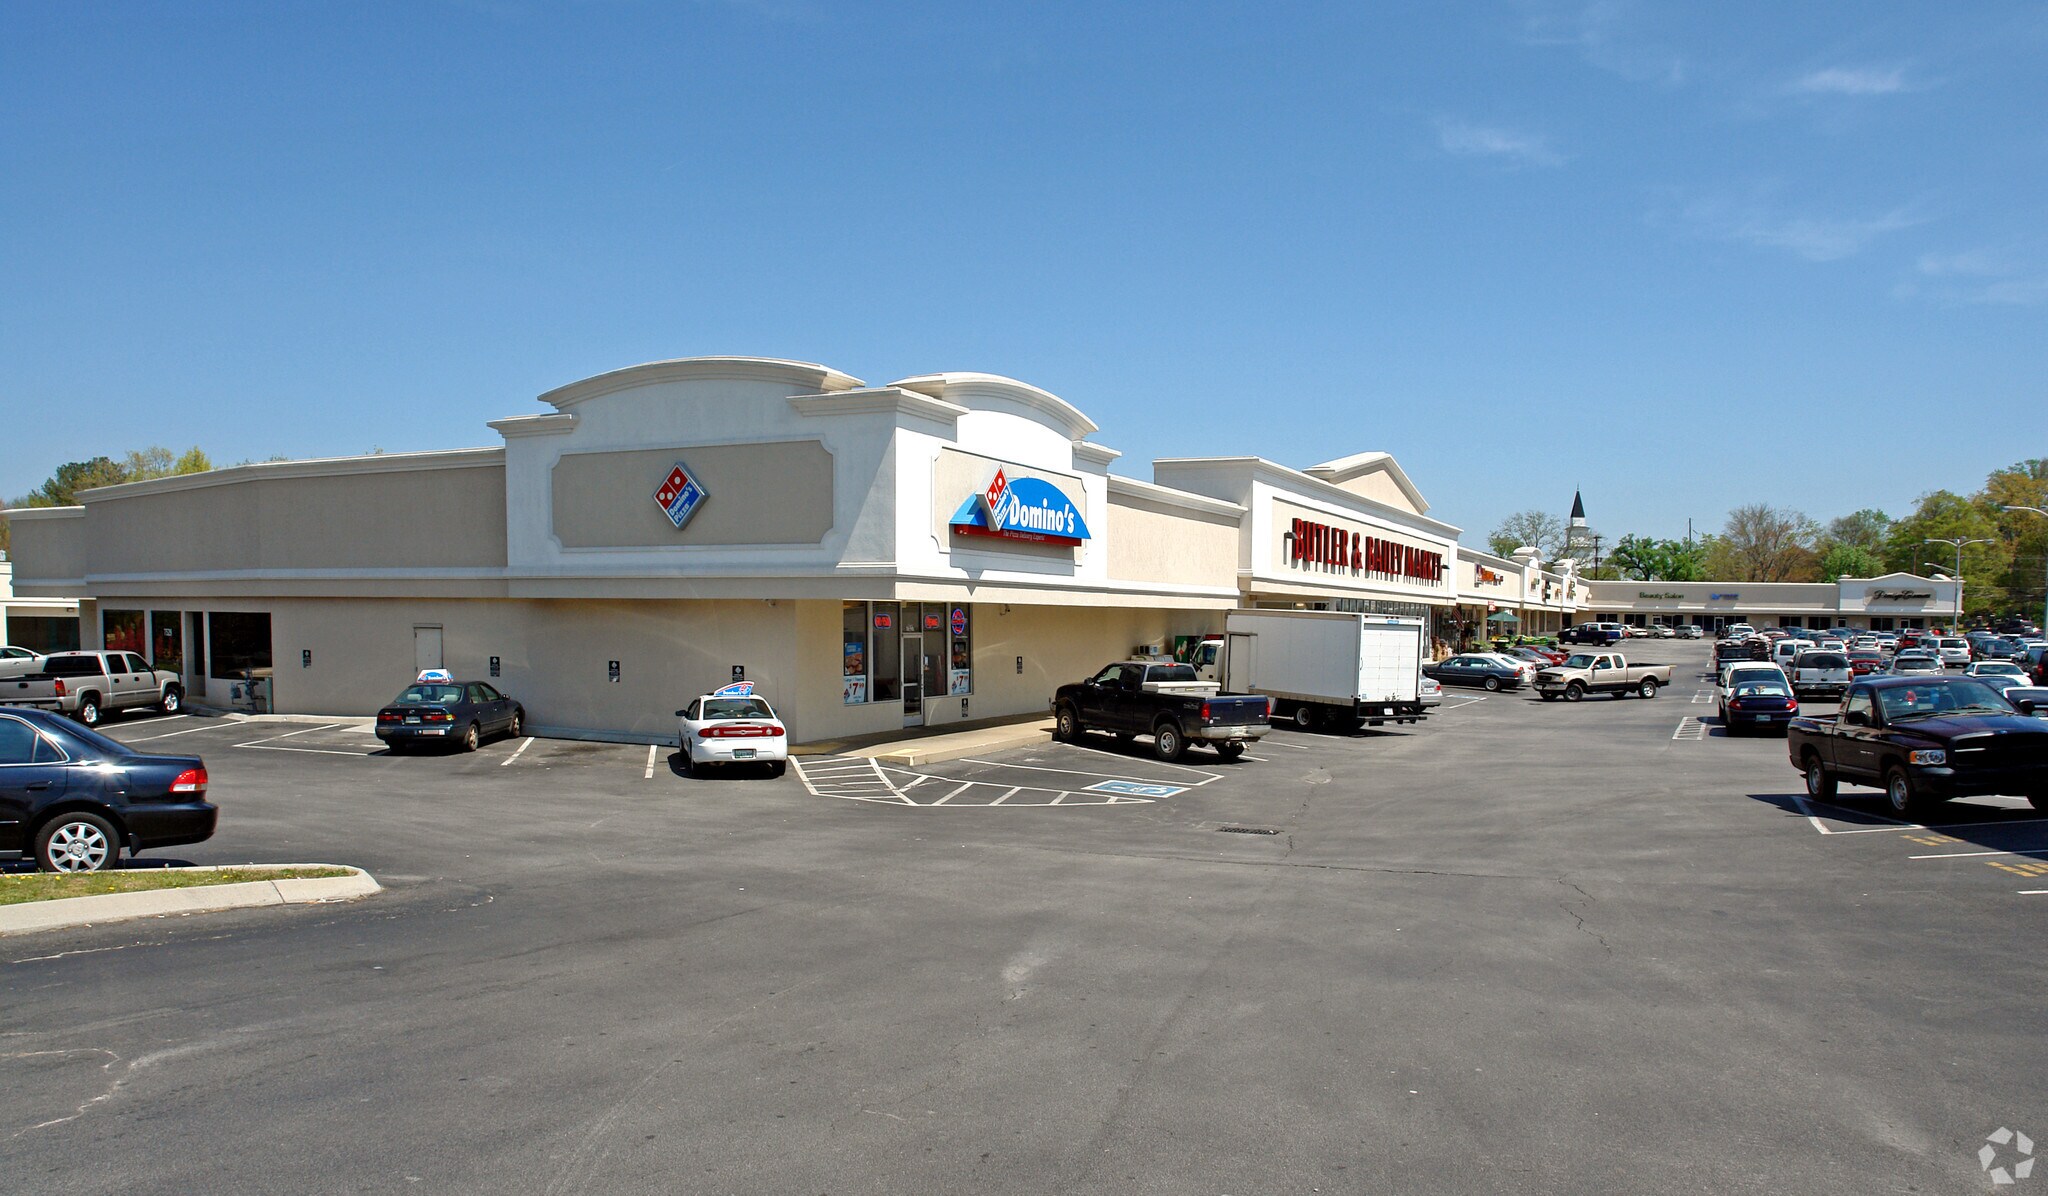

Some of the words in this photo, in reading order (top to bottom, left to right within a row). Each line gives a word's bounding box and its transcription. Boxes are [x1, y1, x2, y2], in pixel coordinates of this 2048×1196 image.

[669, 486, 693, 516] Domino's
[673, 503, 690, 523] Pizza
[1009, 494, 1075, 534] Domino's
[1292, 517, 1349, 567] BUTLER
[1352, 532, 1363, 569] &
[1365, 536, 1404, 576] BAILEY
[1404, 545, 1443, 582] MARKET
[1639, 592, 1664, 600] Beauty
